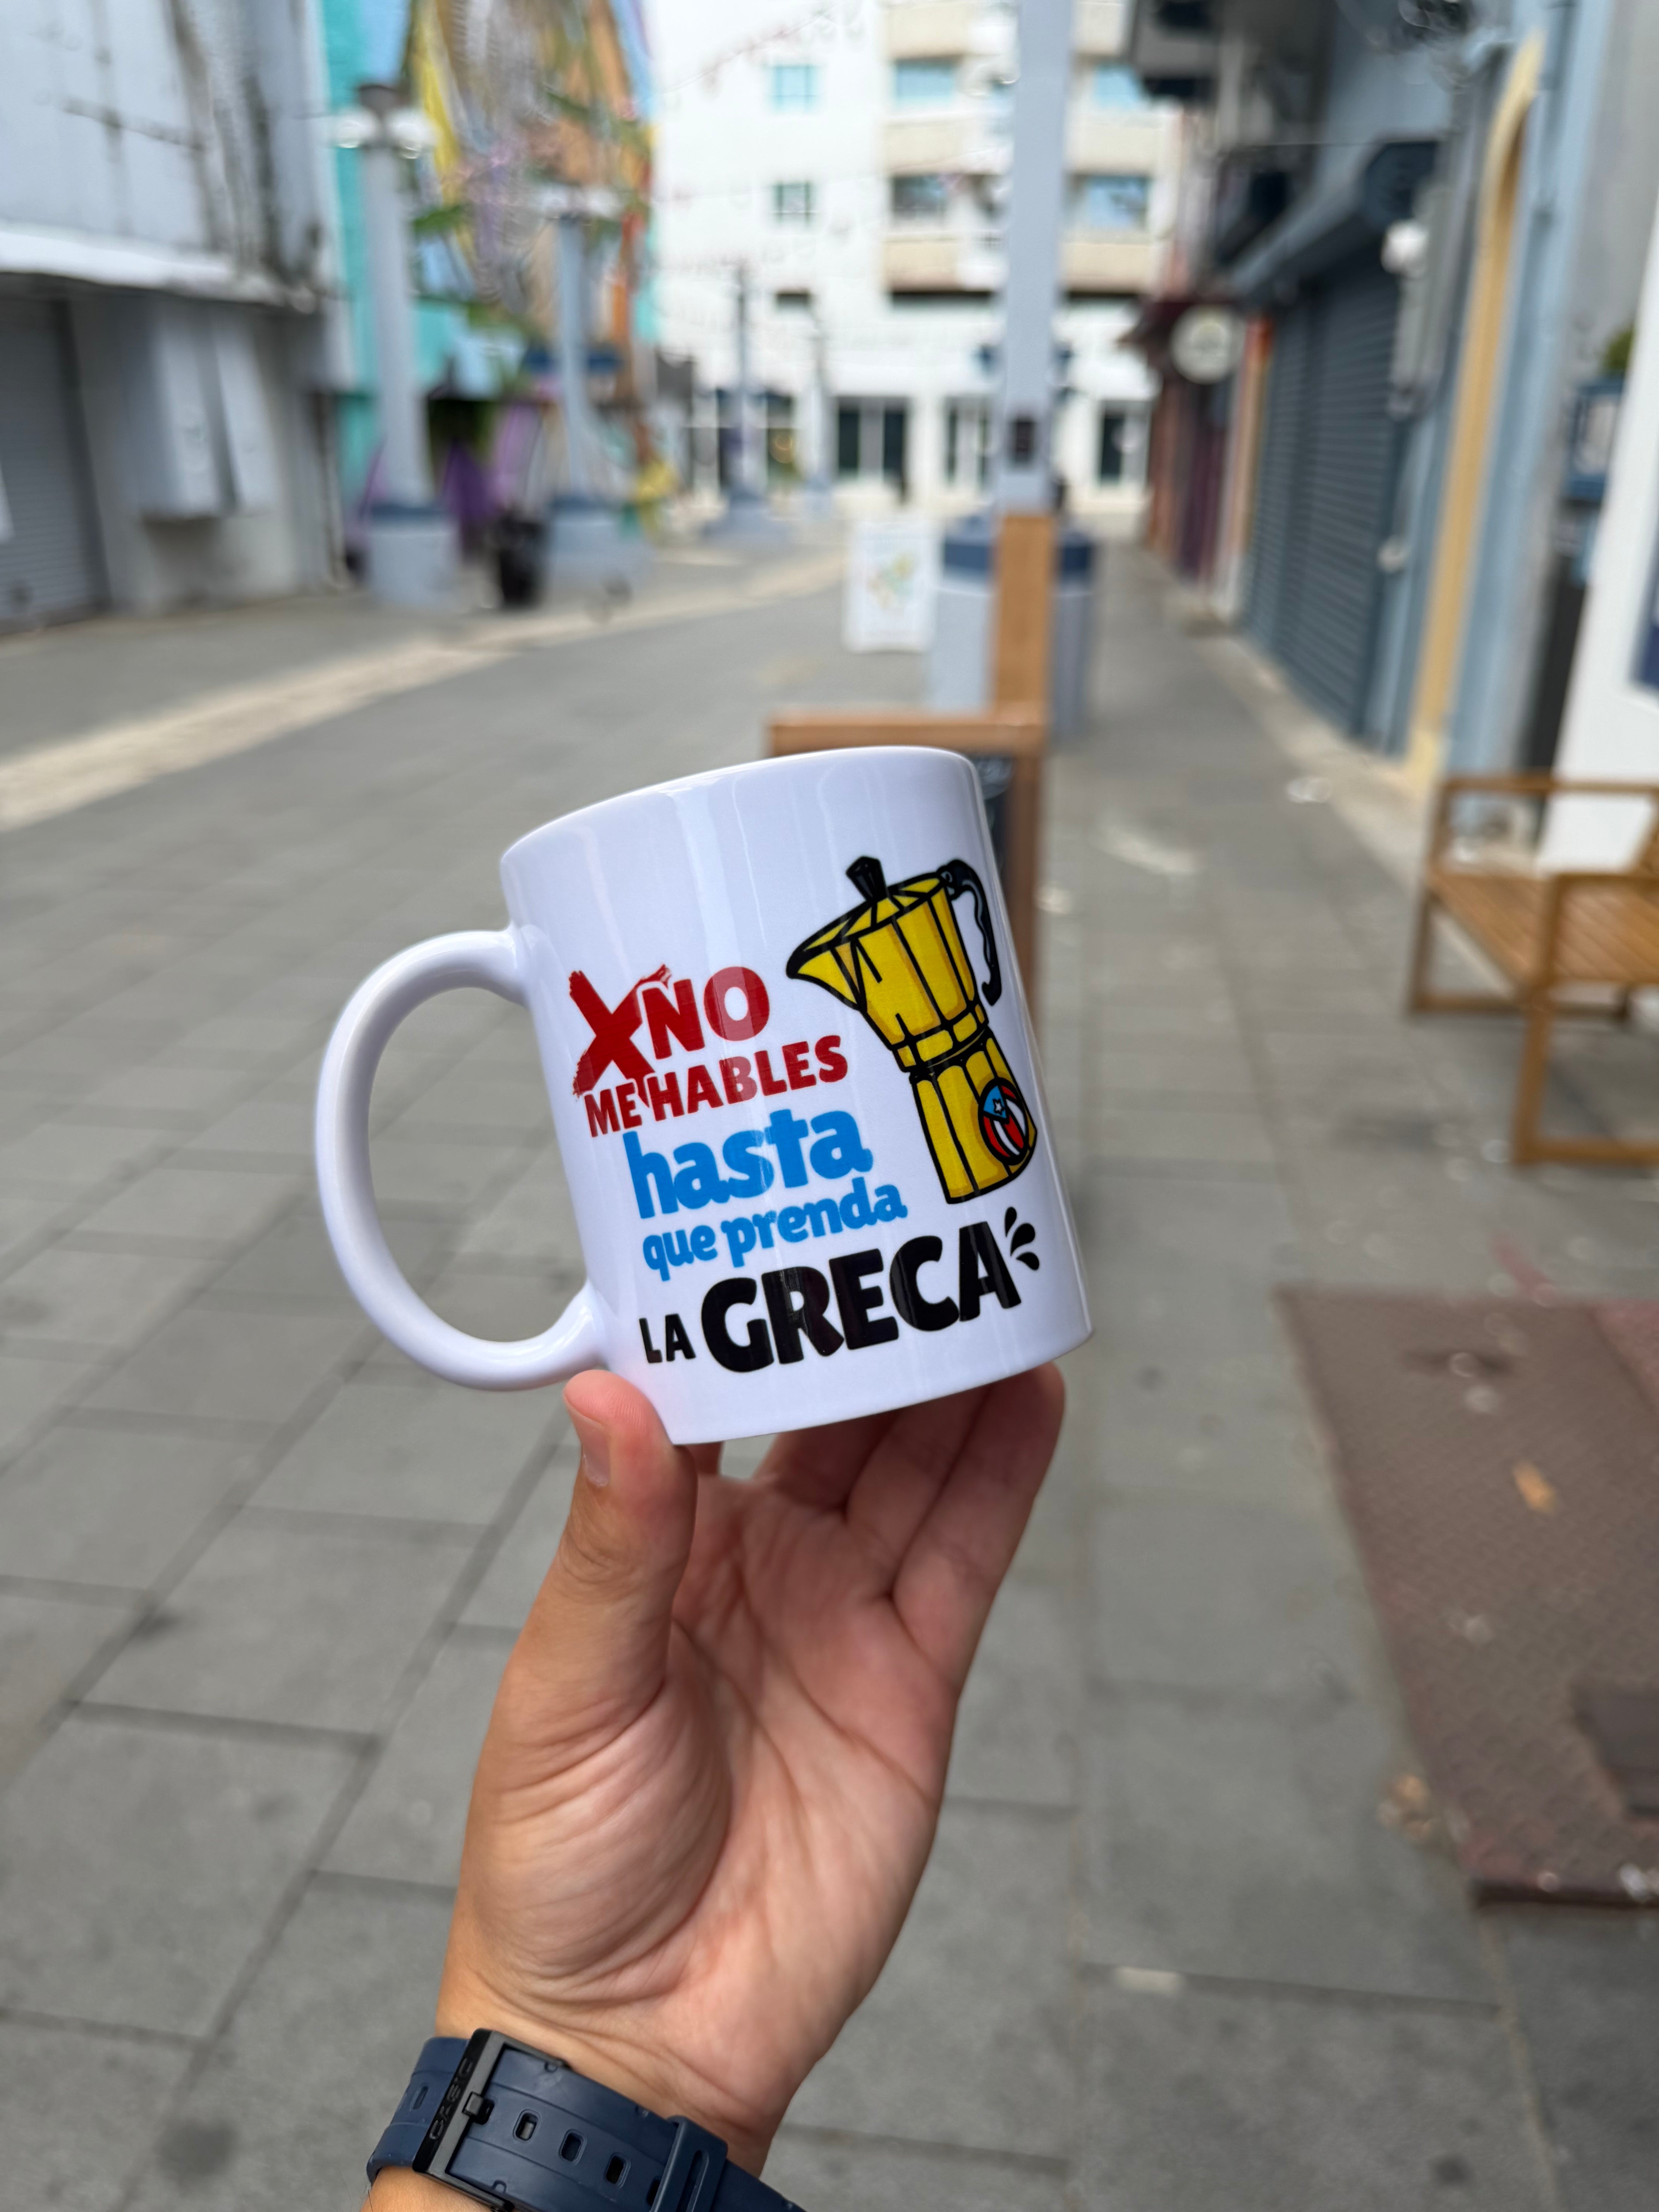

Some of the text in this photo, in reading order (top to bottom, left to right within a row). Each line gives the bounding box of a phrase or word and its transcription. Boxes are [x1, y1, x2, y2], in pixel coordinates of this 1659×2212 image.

[584, 1035, 848, 1137] ME HABLES
[622, 1108, 875, 1220] hasta
[642, 1175, 909, 1283] que prenda
[639, 1221, 1022, 1373] LA GRECA
